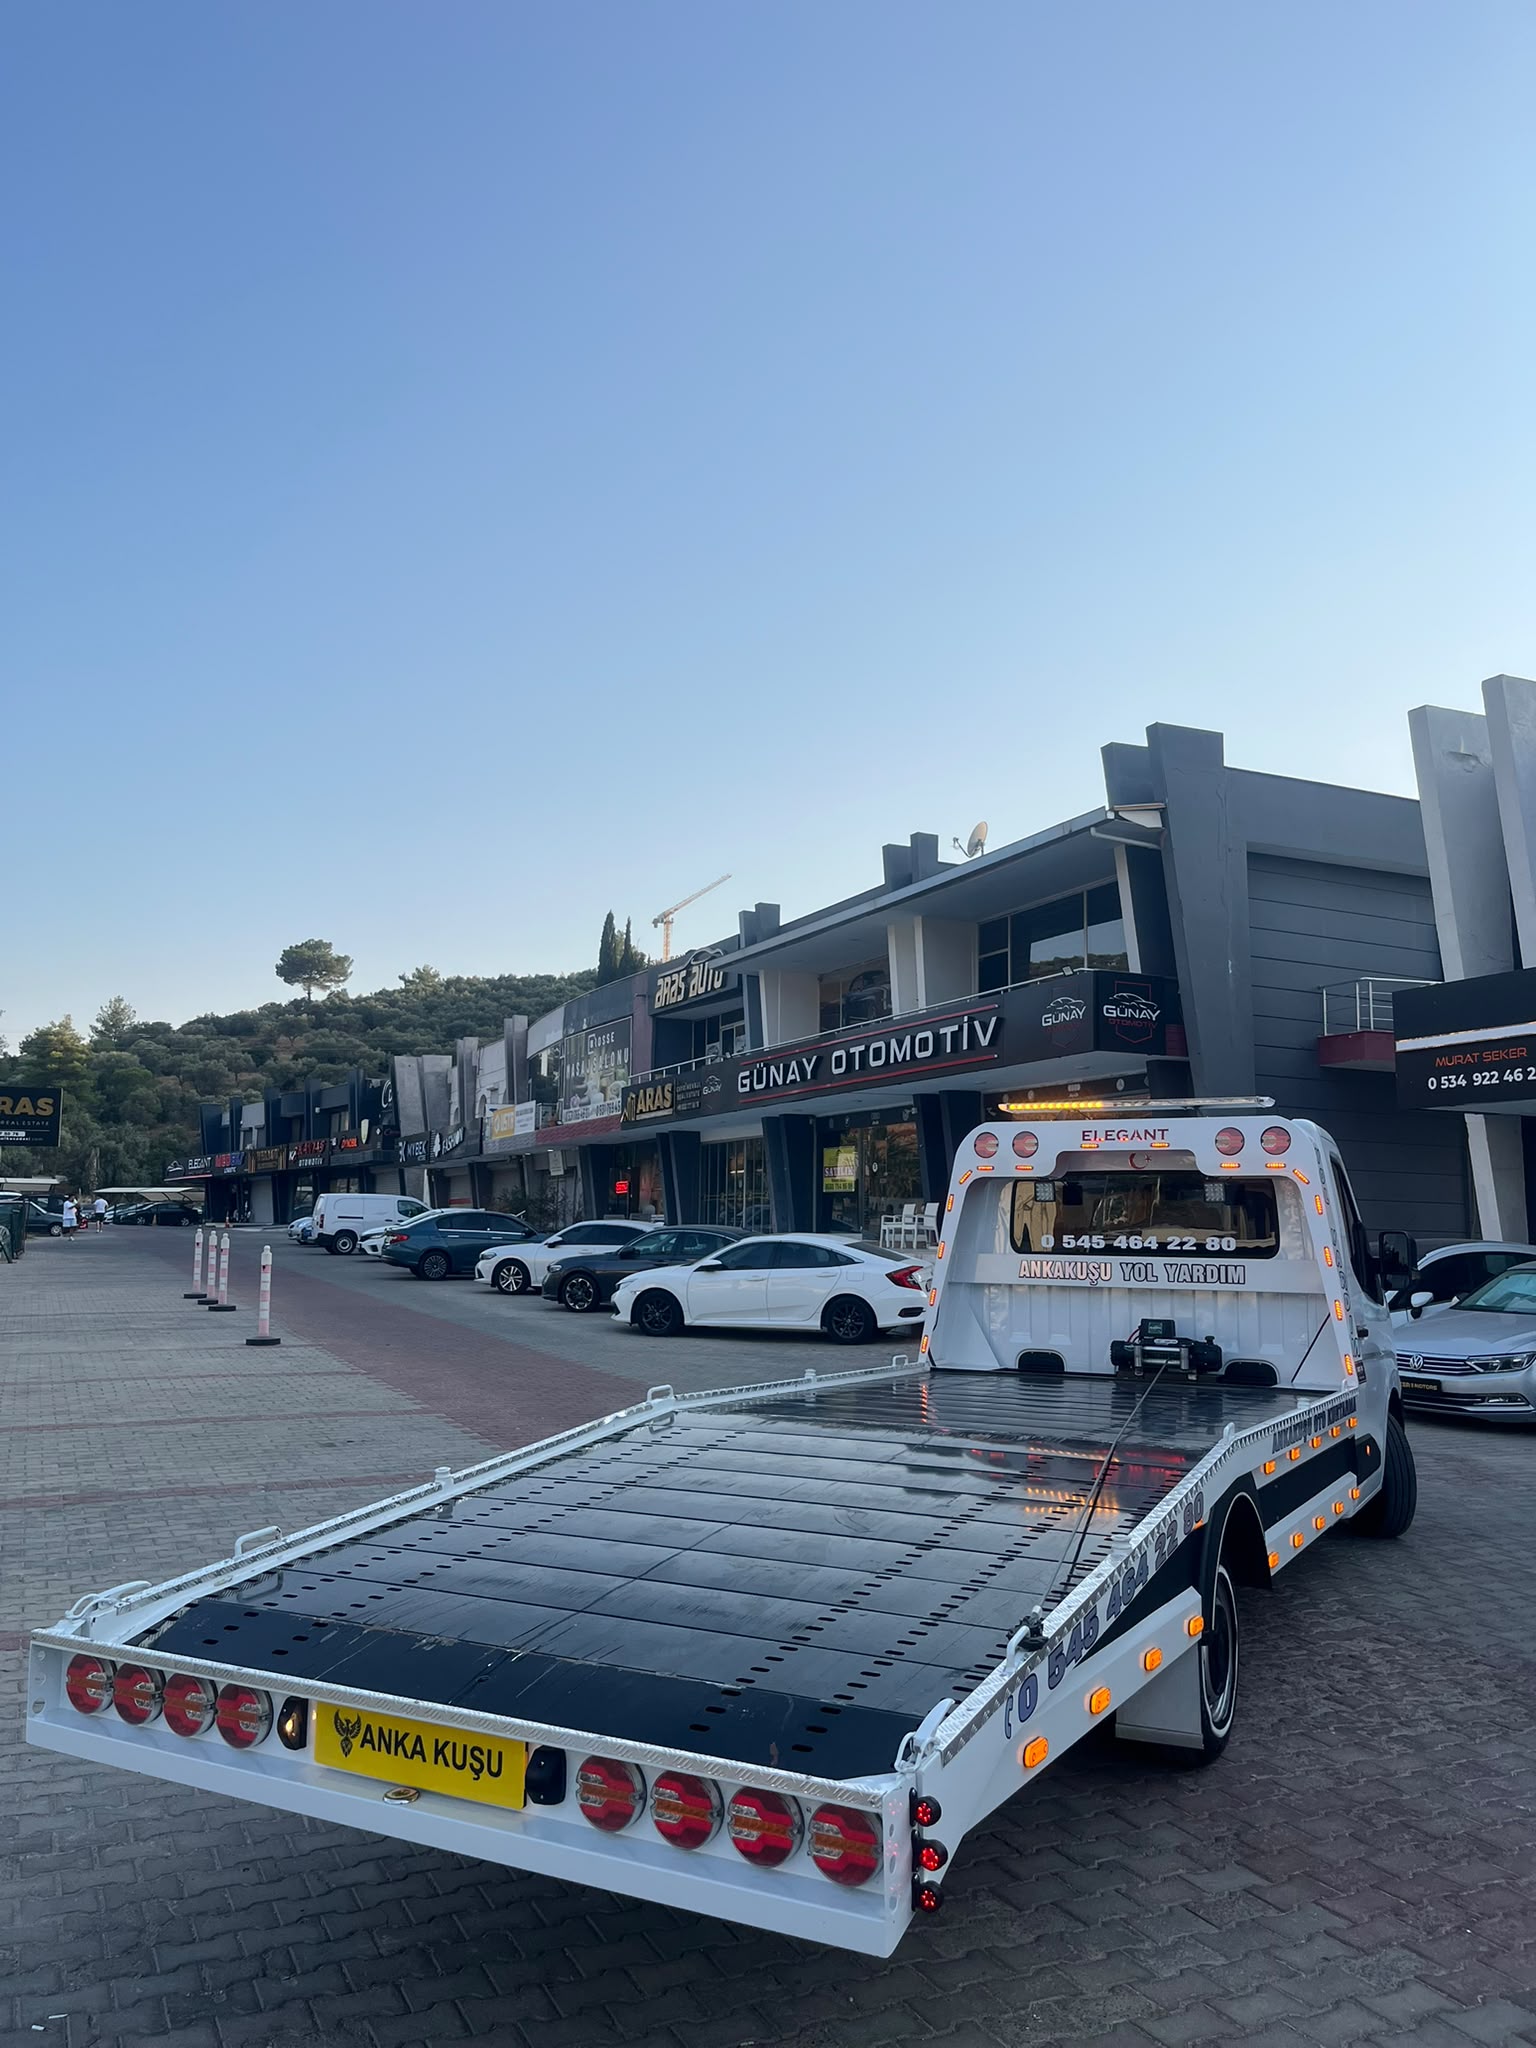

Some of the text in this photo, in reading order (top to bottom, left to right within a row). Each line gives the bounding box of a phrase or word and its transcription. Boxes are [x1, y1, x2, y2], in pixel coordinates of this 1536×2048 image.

[1042, 1005, 1087, 1027] GÜNAY
[1103, 1004, 1160, 1021] GÜNAY
[737, 1014, 998, 1094] GÜNAY OTOMOTİV
[1435, 1052, 1480, 1068] MURAT
[1428, 1077, 1438, 1091] 0
[1440, 1073, 1468, 1090] 534
[1472, 1070, 1500, 1087] 922
[1503, 1068, 1523, 1083] 46
[636, 1083, 673, 1114] ARAS
[1082, 1127, 1169, 1142] ELEGANT
[1041, 1234, 1237, 1252] 0 545 464 22 80
[1018, 1259, 1246, 1286] ANKAKUŞU YOL YARDIM
[1018, 1491, 1205, 1724] 0 545 464 22 80
[359, 1723, 504, 1782] ANKA KUŞU
